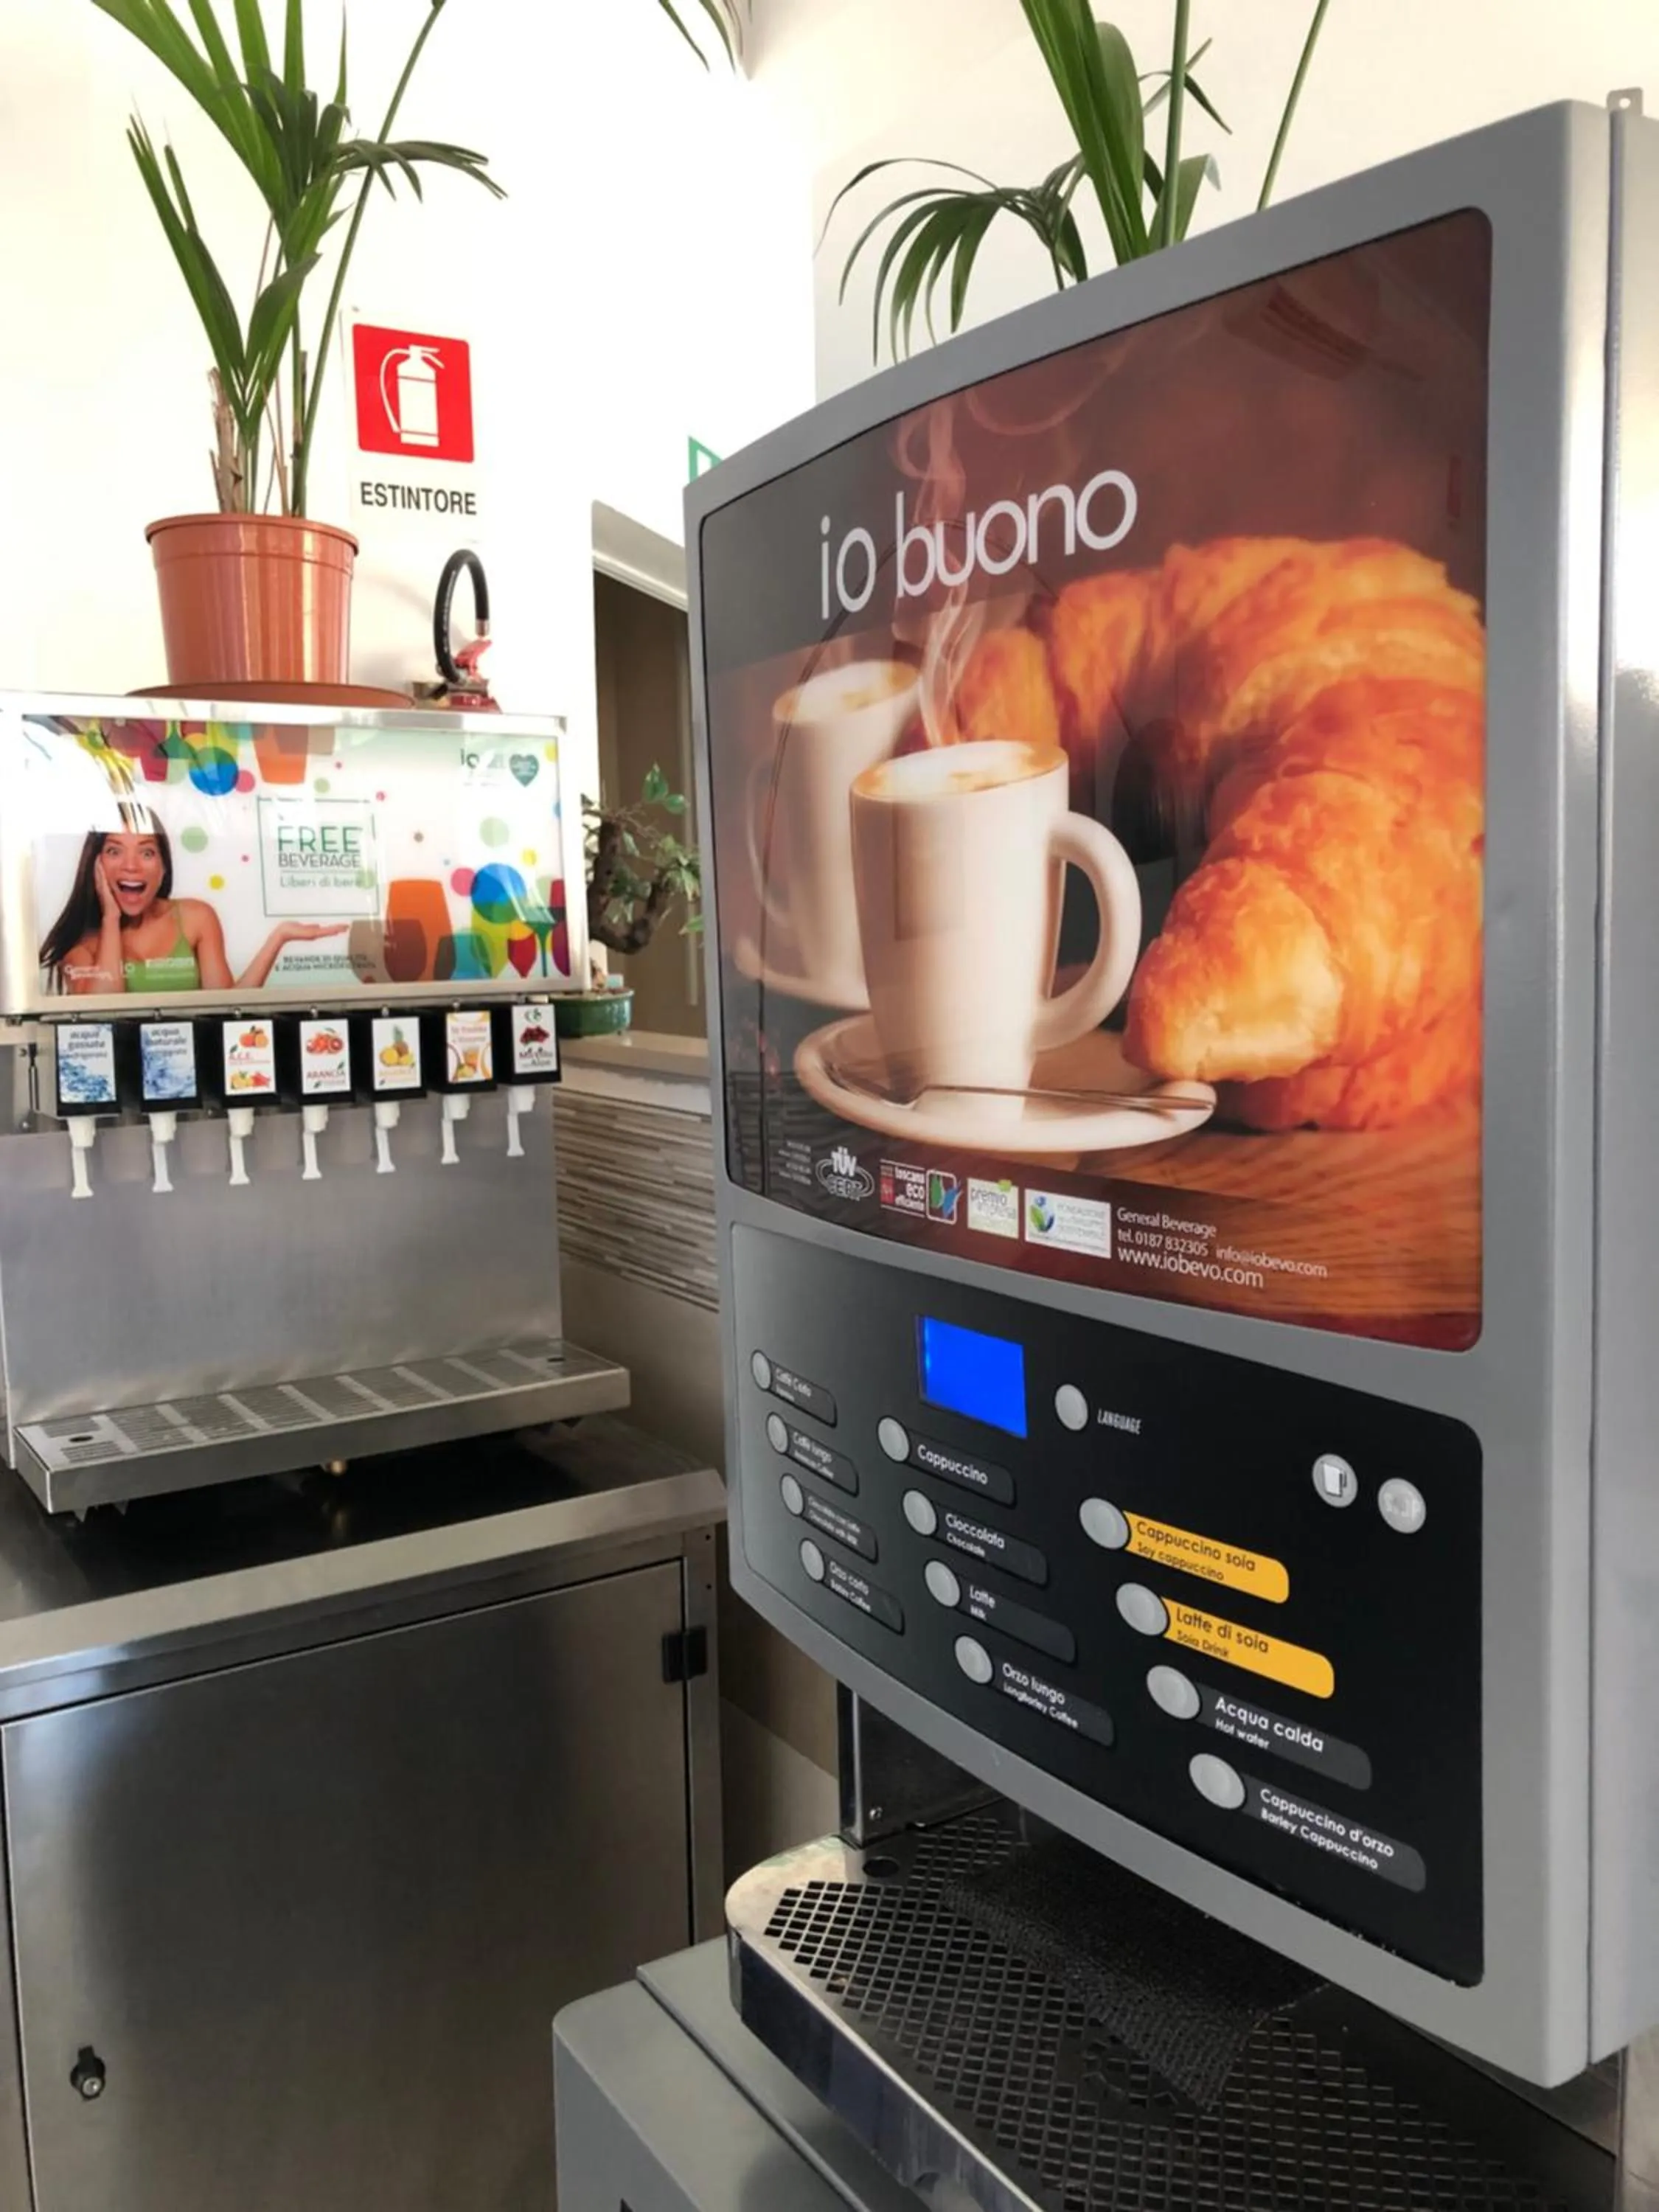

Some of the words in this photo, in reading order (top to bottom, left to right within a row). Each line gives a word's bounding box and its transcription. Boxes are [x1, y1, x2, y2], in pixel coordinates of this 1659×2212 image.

[360, 481, 477, 515] ESTINTORE
[820, 515, 876, 619] io
[896, 470, 1138, 597] buono
[277, 826, 363, 853] FREE
[278, 853, 361, 868] BEVERAGE
[831, 1146, 857, 1178] TÜV
[905, 1182, 925, 1200] eco
[970, 1188, 1007, 1206] premio
[1116, 1207, 1160, 1226] General
[1161, 1214, 1217, 1239] Beverage
[1117, 1229, 1133, 1242] tel.
[1135, 1231, 1163, 1247] 0187
[1164, 1237, 1208, 1256] 832305
[1217, 1245, 1327, 1278] info@iobevo.com
[1117, 1247, 1264, 1288] www.iobevo.com
[1097, 1408, 1141, 1435] LANGUAGE
[917, 1444, 989, 1485] Cappuccino
[945, 1513, 1005, 1549] Cioccolata
[1136, 1521, 1221, 1561] Cappuccino
[1225, 1551, 1256, 1571] soia
[1138, 1542, 1155, 1558] Soy
[1158, 1550, 1224, 1581] cappuccino
[970, 1585, 995, 1609] Latte
[1176, 1607, 1212, 1632] Latte
[1217, 1624, 1231, 1640] di
[1236, 1632, 1269, 1653] soia
[1177, 1630, 1200, 1647] Soia
[1203, 1639, 1229, 1658] Drink
[1002, 1663, 1029, 1686] Orzo
[1032, 1676, 1065, 1705] lungo
[1049, 1706, 1079, 1729] Coffee
[1215, 1697, 1269, 1730] Acqua
[1273, 1722, 1324, 1753] calda
[1215, 1719, 1235, 1735] Hot
[1237, 1730, 1270, 1750] water
[1260, 1788, 1346, 1836] Cappuccino
[1349, 1827, 1394, 1857] d'orzo
[1261, 1807, 1298, 1834] Barley
[1300, 1826, 1378, 1870] Cappuccino
